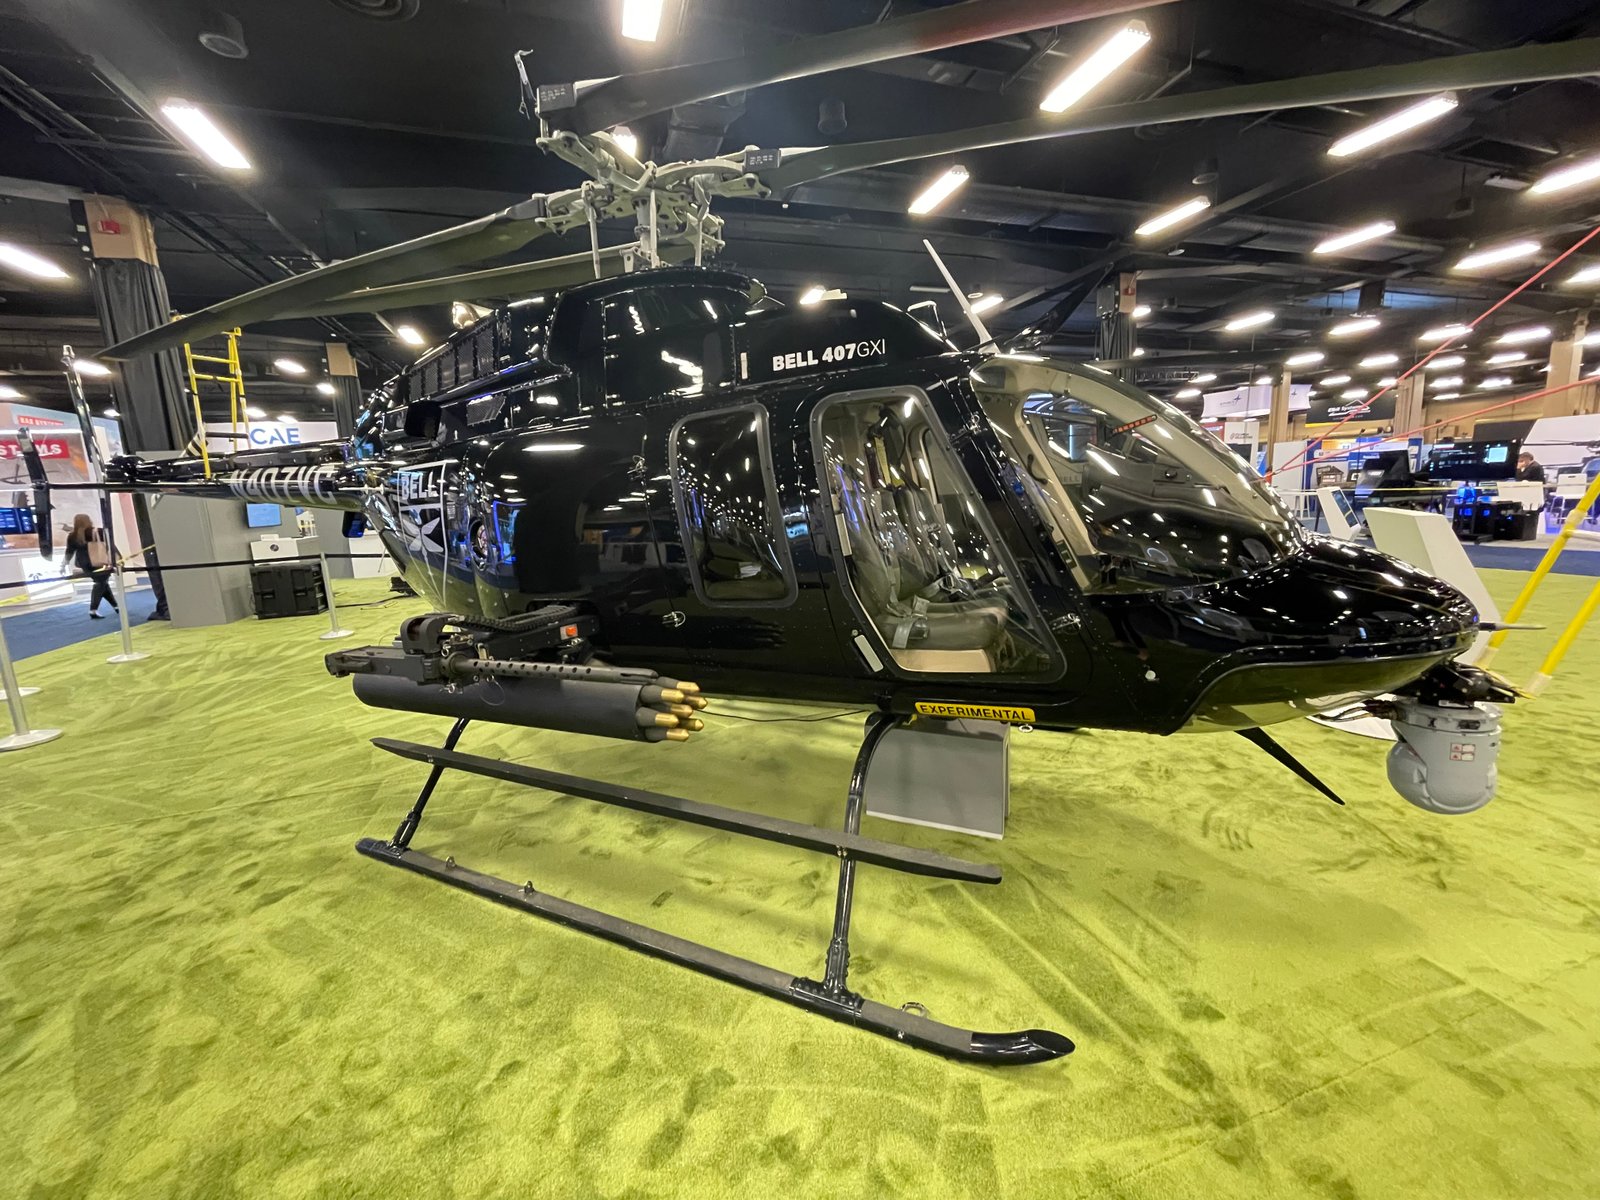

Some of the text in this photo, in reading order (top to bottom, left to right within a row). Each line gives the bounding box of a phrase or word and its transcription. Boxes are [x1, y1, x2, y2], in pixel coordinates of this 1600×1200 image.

[772, 339, 886, 371] BELL 407GXI
[250, 428, 301, 444] CAE
[0, 444, 63, 456] STMS
[401, 471, 439, 500] BELL
[919, 704, 1031, 721] EXPERIMENTAL
